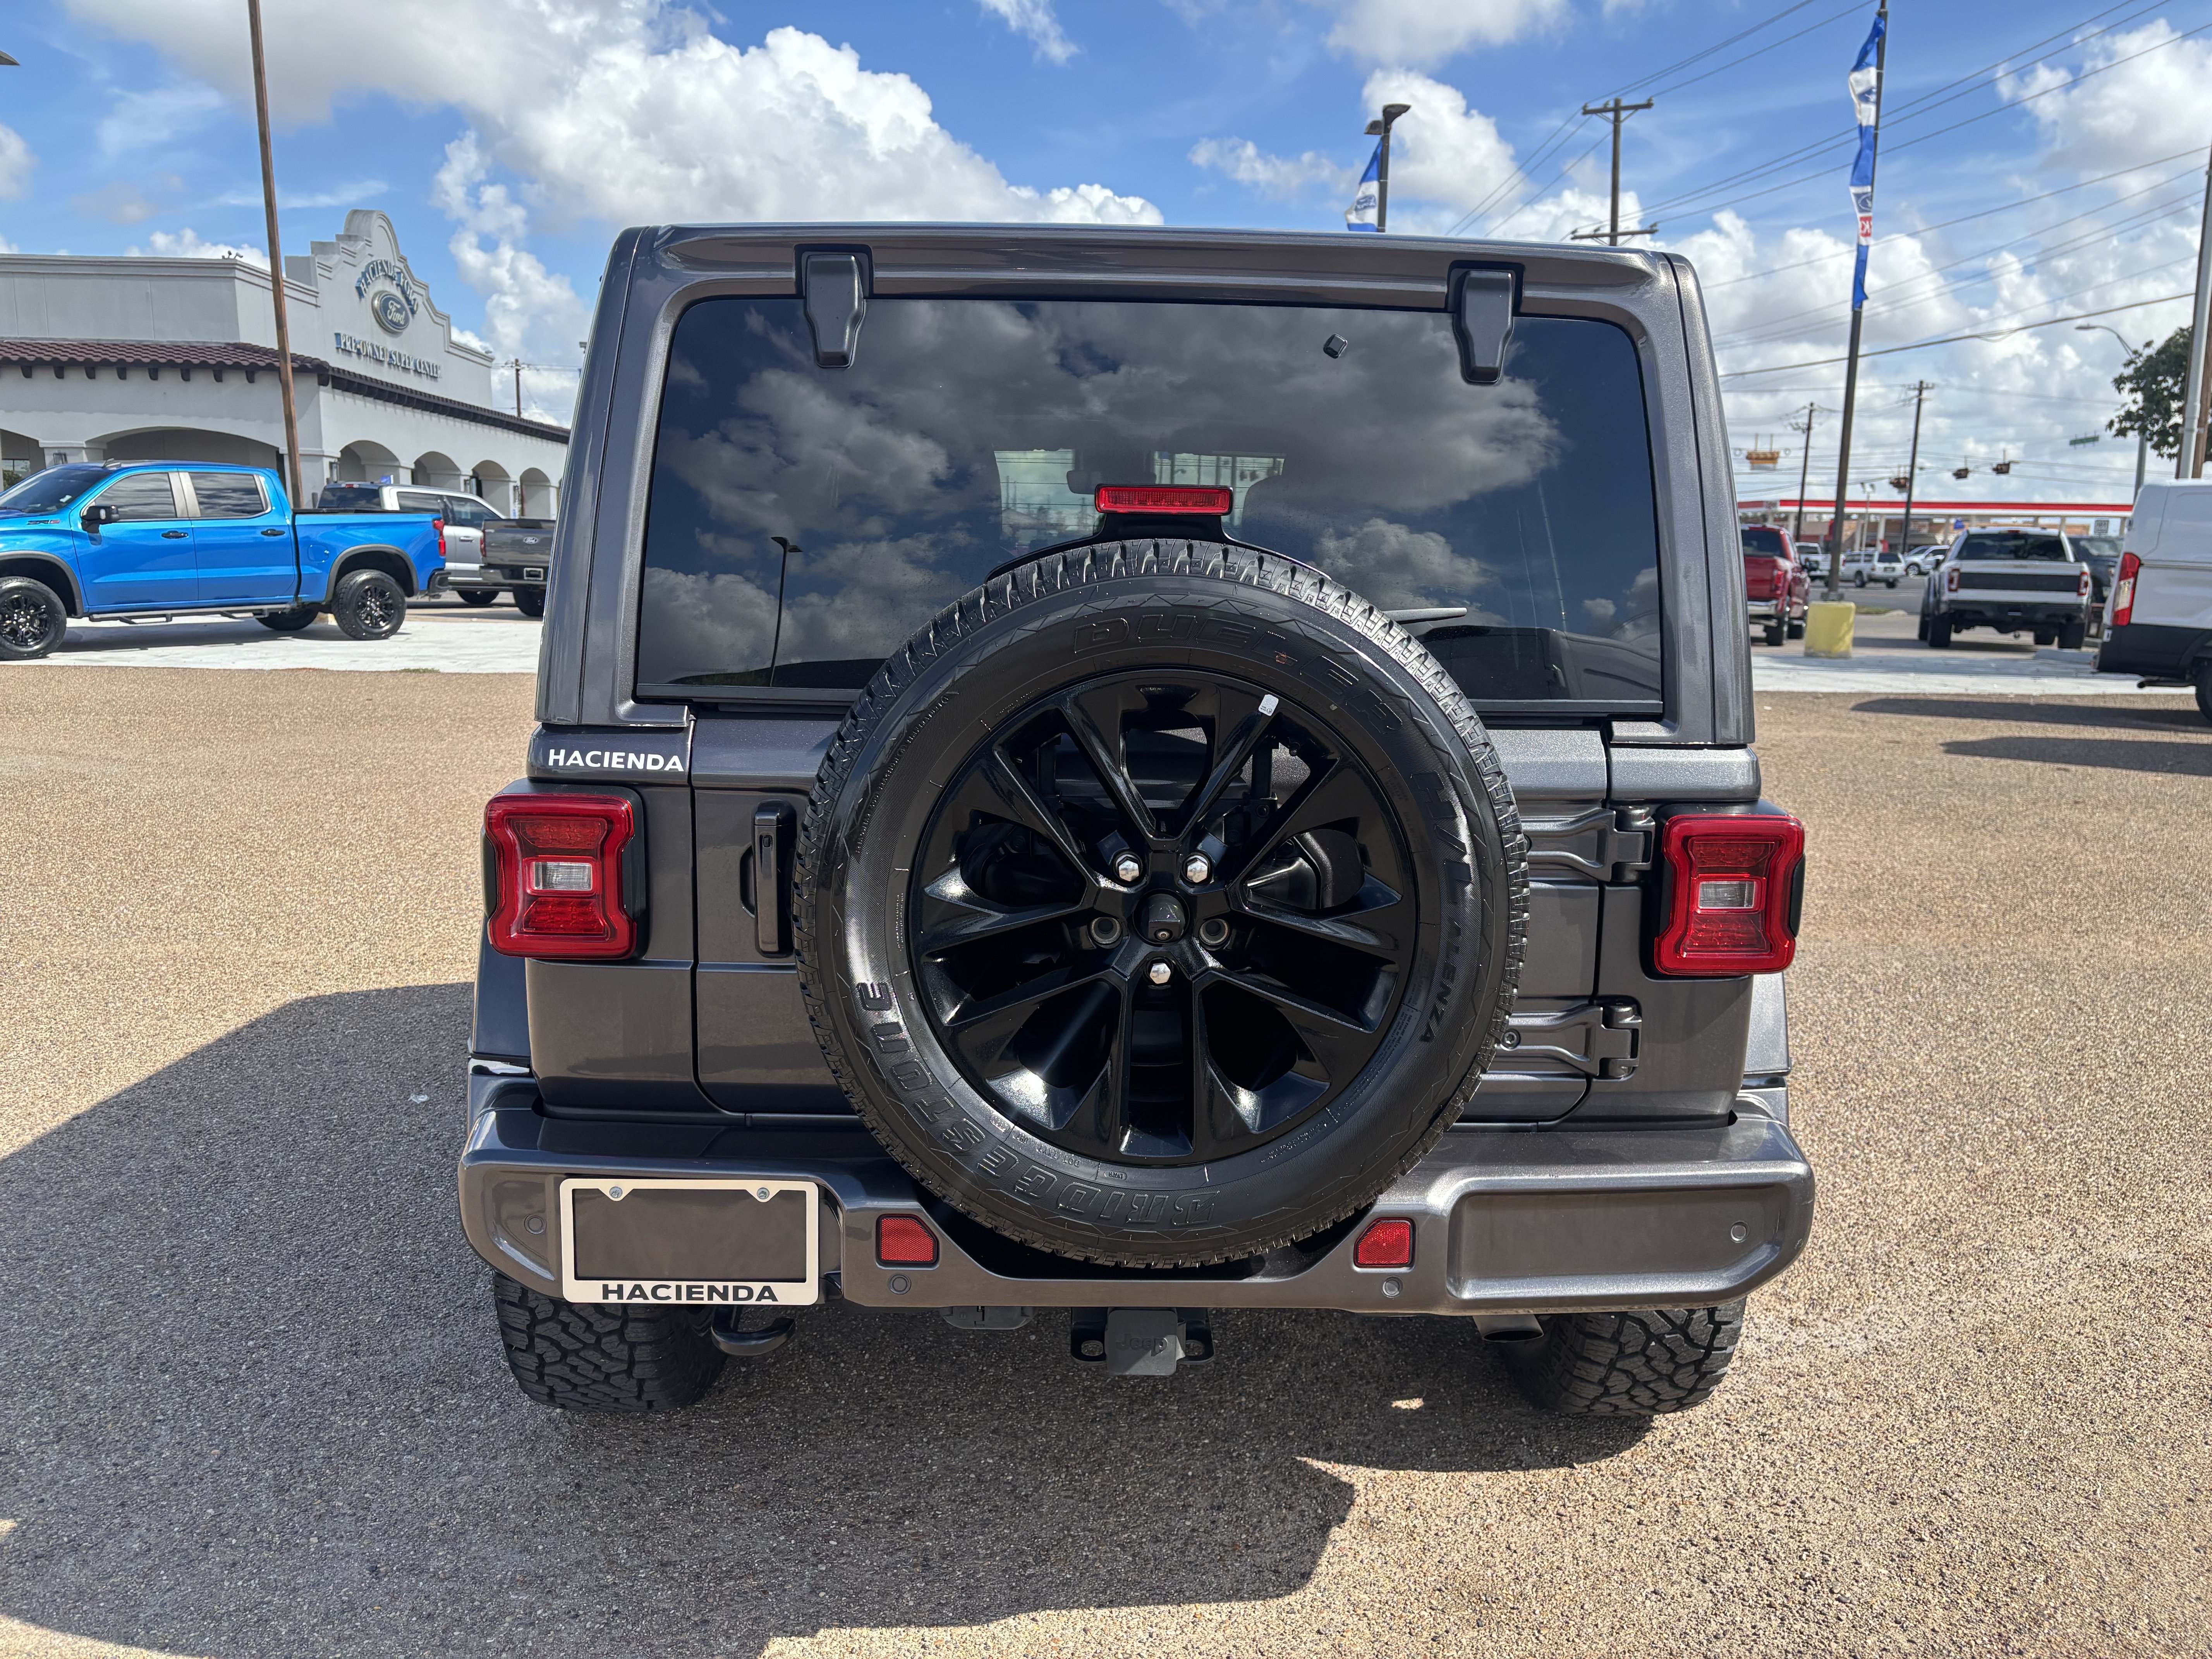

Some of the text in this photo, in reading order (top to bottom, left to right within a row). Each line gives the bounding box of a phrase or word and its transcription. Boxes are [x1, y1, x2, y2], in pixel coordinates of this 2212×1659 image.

[356, 259, 399, 299] HACIENDA
[387, 300, 406, 325] Ford
[335, 332, 442, 378] PRE-OWNED SUPER CENTER
[548, 749, 684, 772] HACIENDA
[1073, 613, 1403, 735] DUELER
[1420, 921, 1462, 1043] ALENZA
[856, 981, 1221, 1226] BRIDGESTONE
[602, 1284, 779, 1302] HACIENDA
[1115, 1333, 1168, 1357] Jeep
